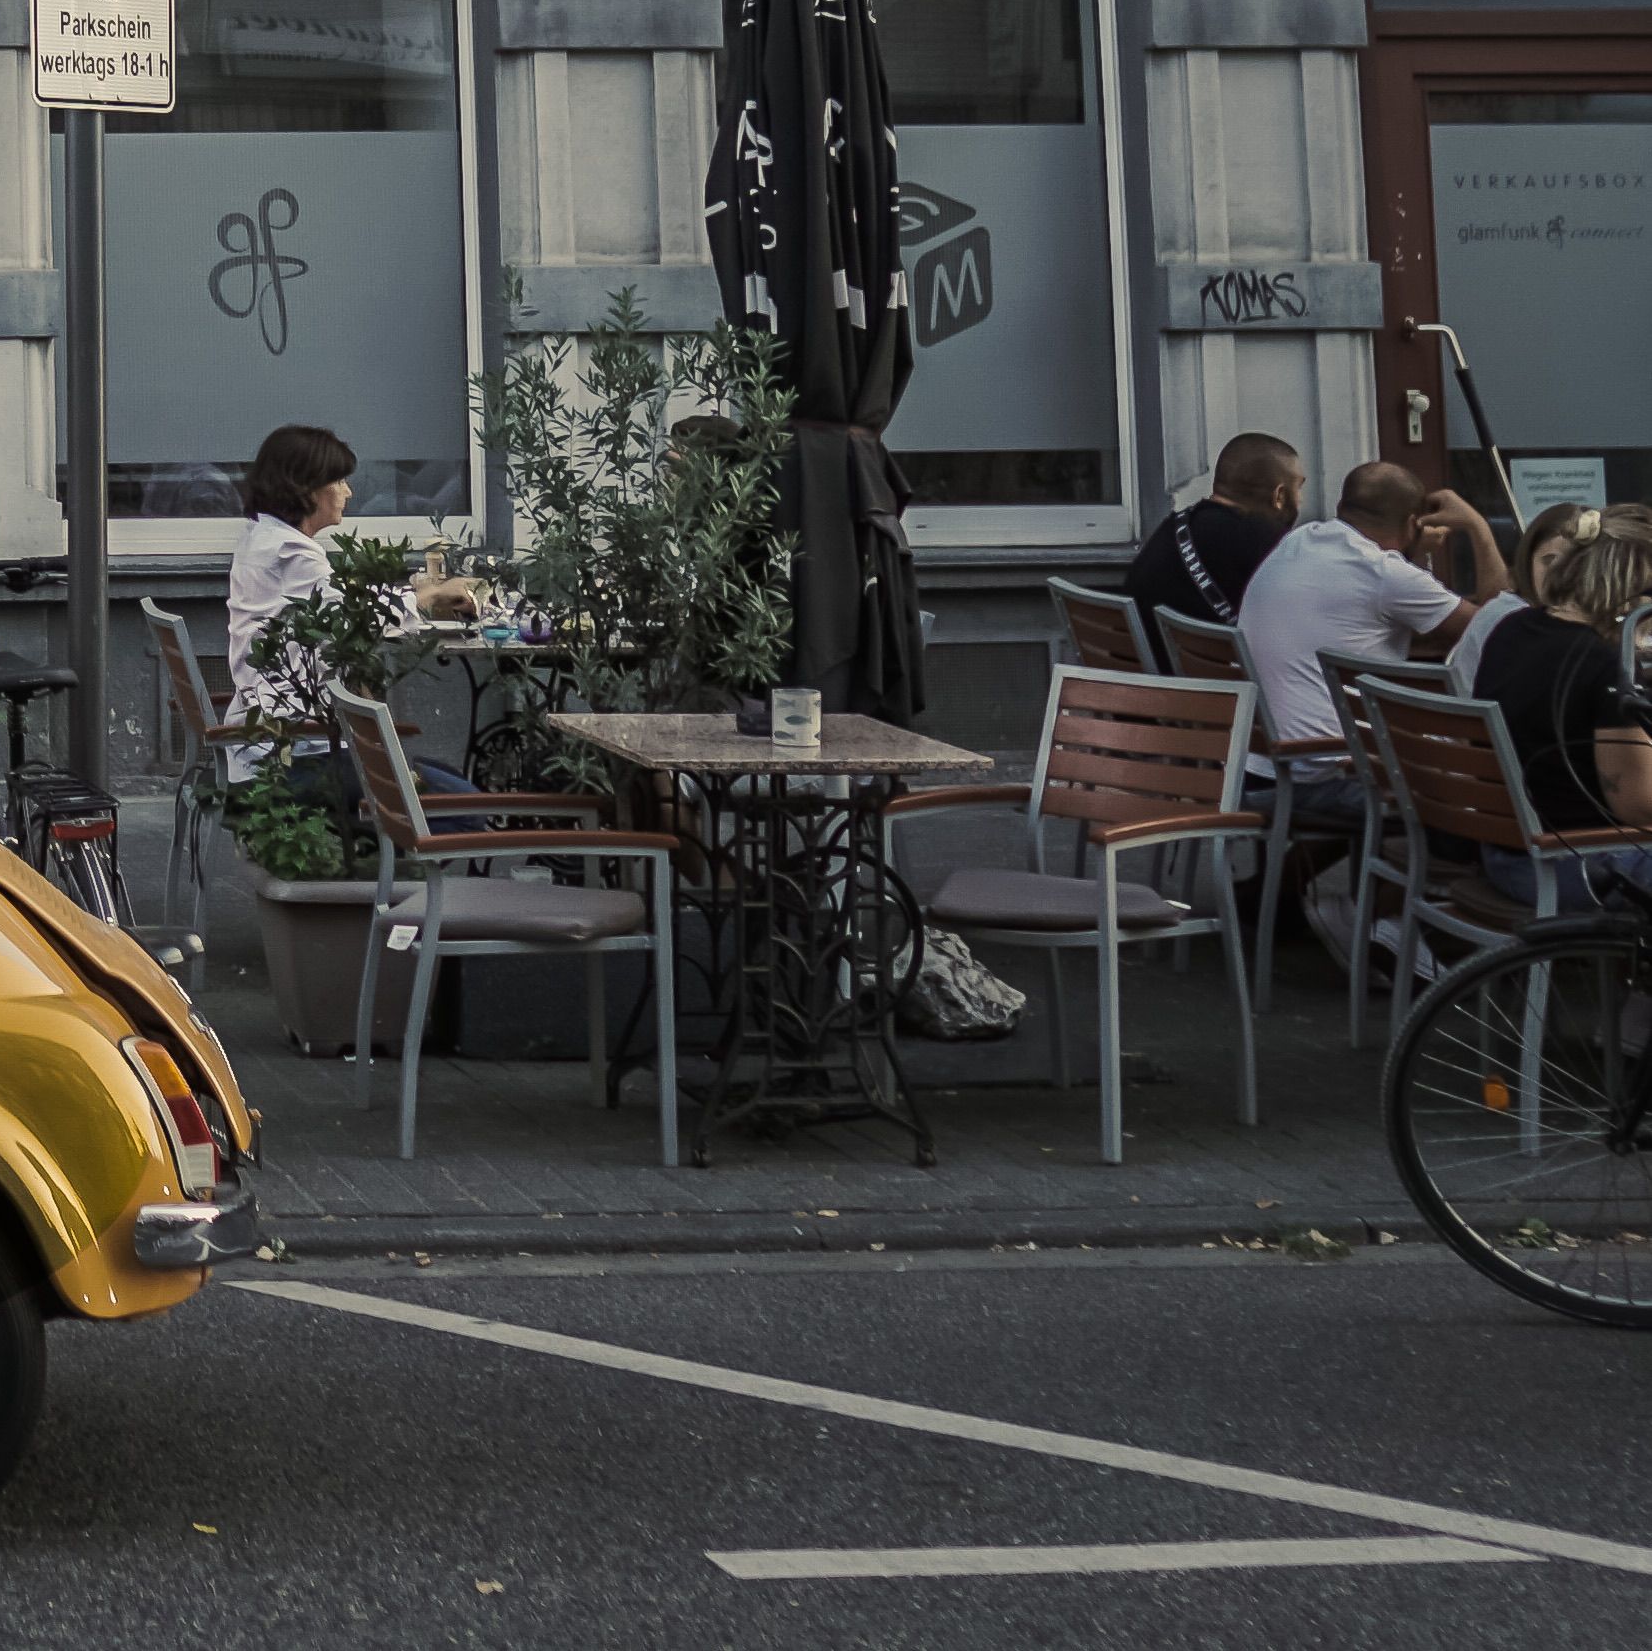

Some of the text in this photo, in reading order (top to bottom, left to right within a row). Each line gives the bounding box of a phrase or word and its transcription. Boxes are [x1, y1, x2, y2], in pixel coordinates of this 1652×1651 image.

[60, 10, 151, 40] Parkschein
[40, 49, 169, 81] werktags 18-1 h
[1454, 173, 1644, 190] VERKAUFSBOX
[1457, 222, 1539, 244] glamfunk
